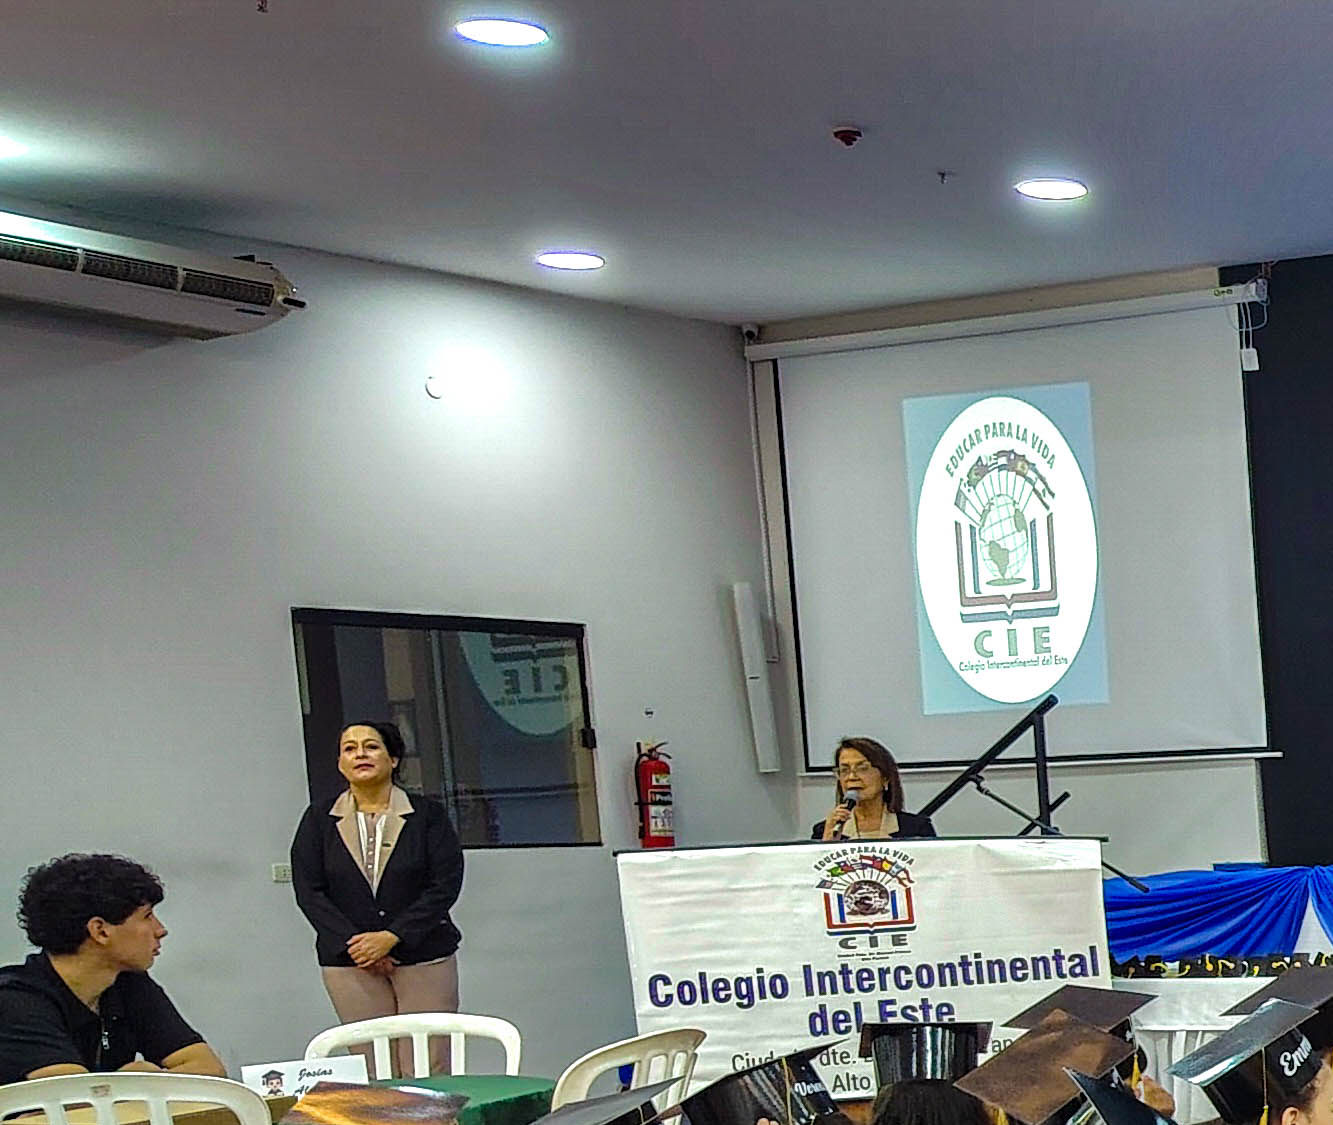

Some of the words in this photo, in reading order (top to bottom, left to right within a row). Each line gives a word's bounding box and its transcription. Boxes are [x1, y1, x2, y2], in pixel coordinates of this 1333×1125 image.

[945, 428, 983, 478] EDUCAR
[983, 421, 1014, 440] PARA
[1015, 424, 1028, 444] LA
[1031, 432, 1056, 469] VIDA
[974, 626, 1052, 658] CIE
[813, 848, 849, 871] EDUCAR
[850, 846, 877, 854] PARA
[878, 846, 890, 855] LA
[892, 850, 916, 866] VIDA
[838, 933, 909, 950] CIE
[647, 967, 790, 1010] Colegio
[802, 945, 1100, 998] Intercontinental
[808, 1002, 862, 1038] del
[879, 998, 955, 1023] Este
[819, 1047, 857, 1067] dte.
[831, 1071, 872, 1093] Alto
